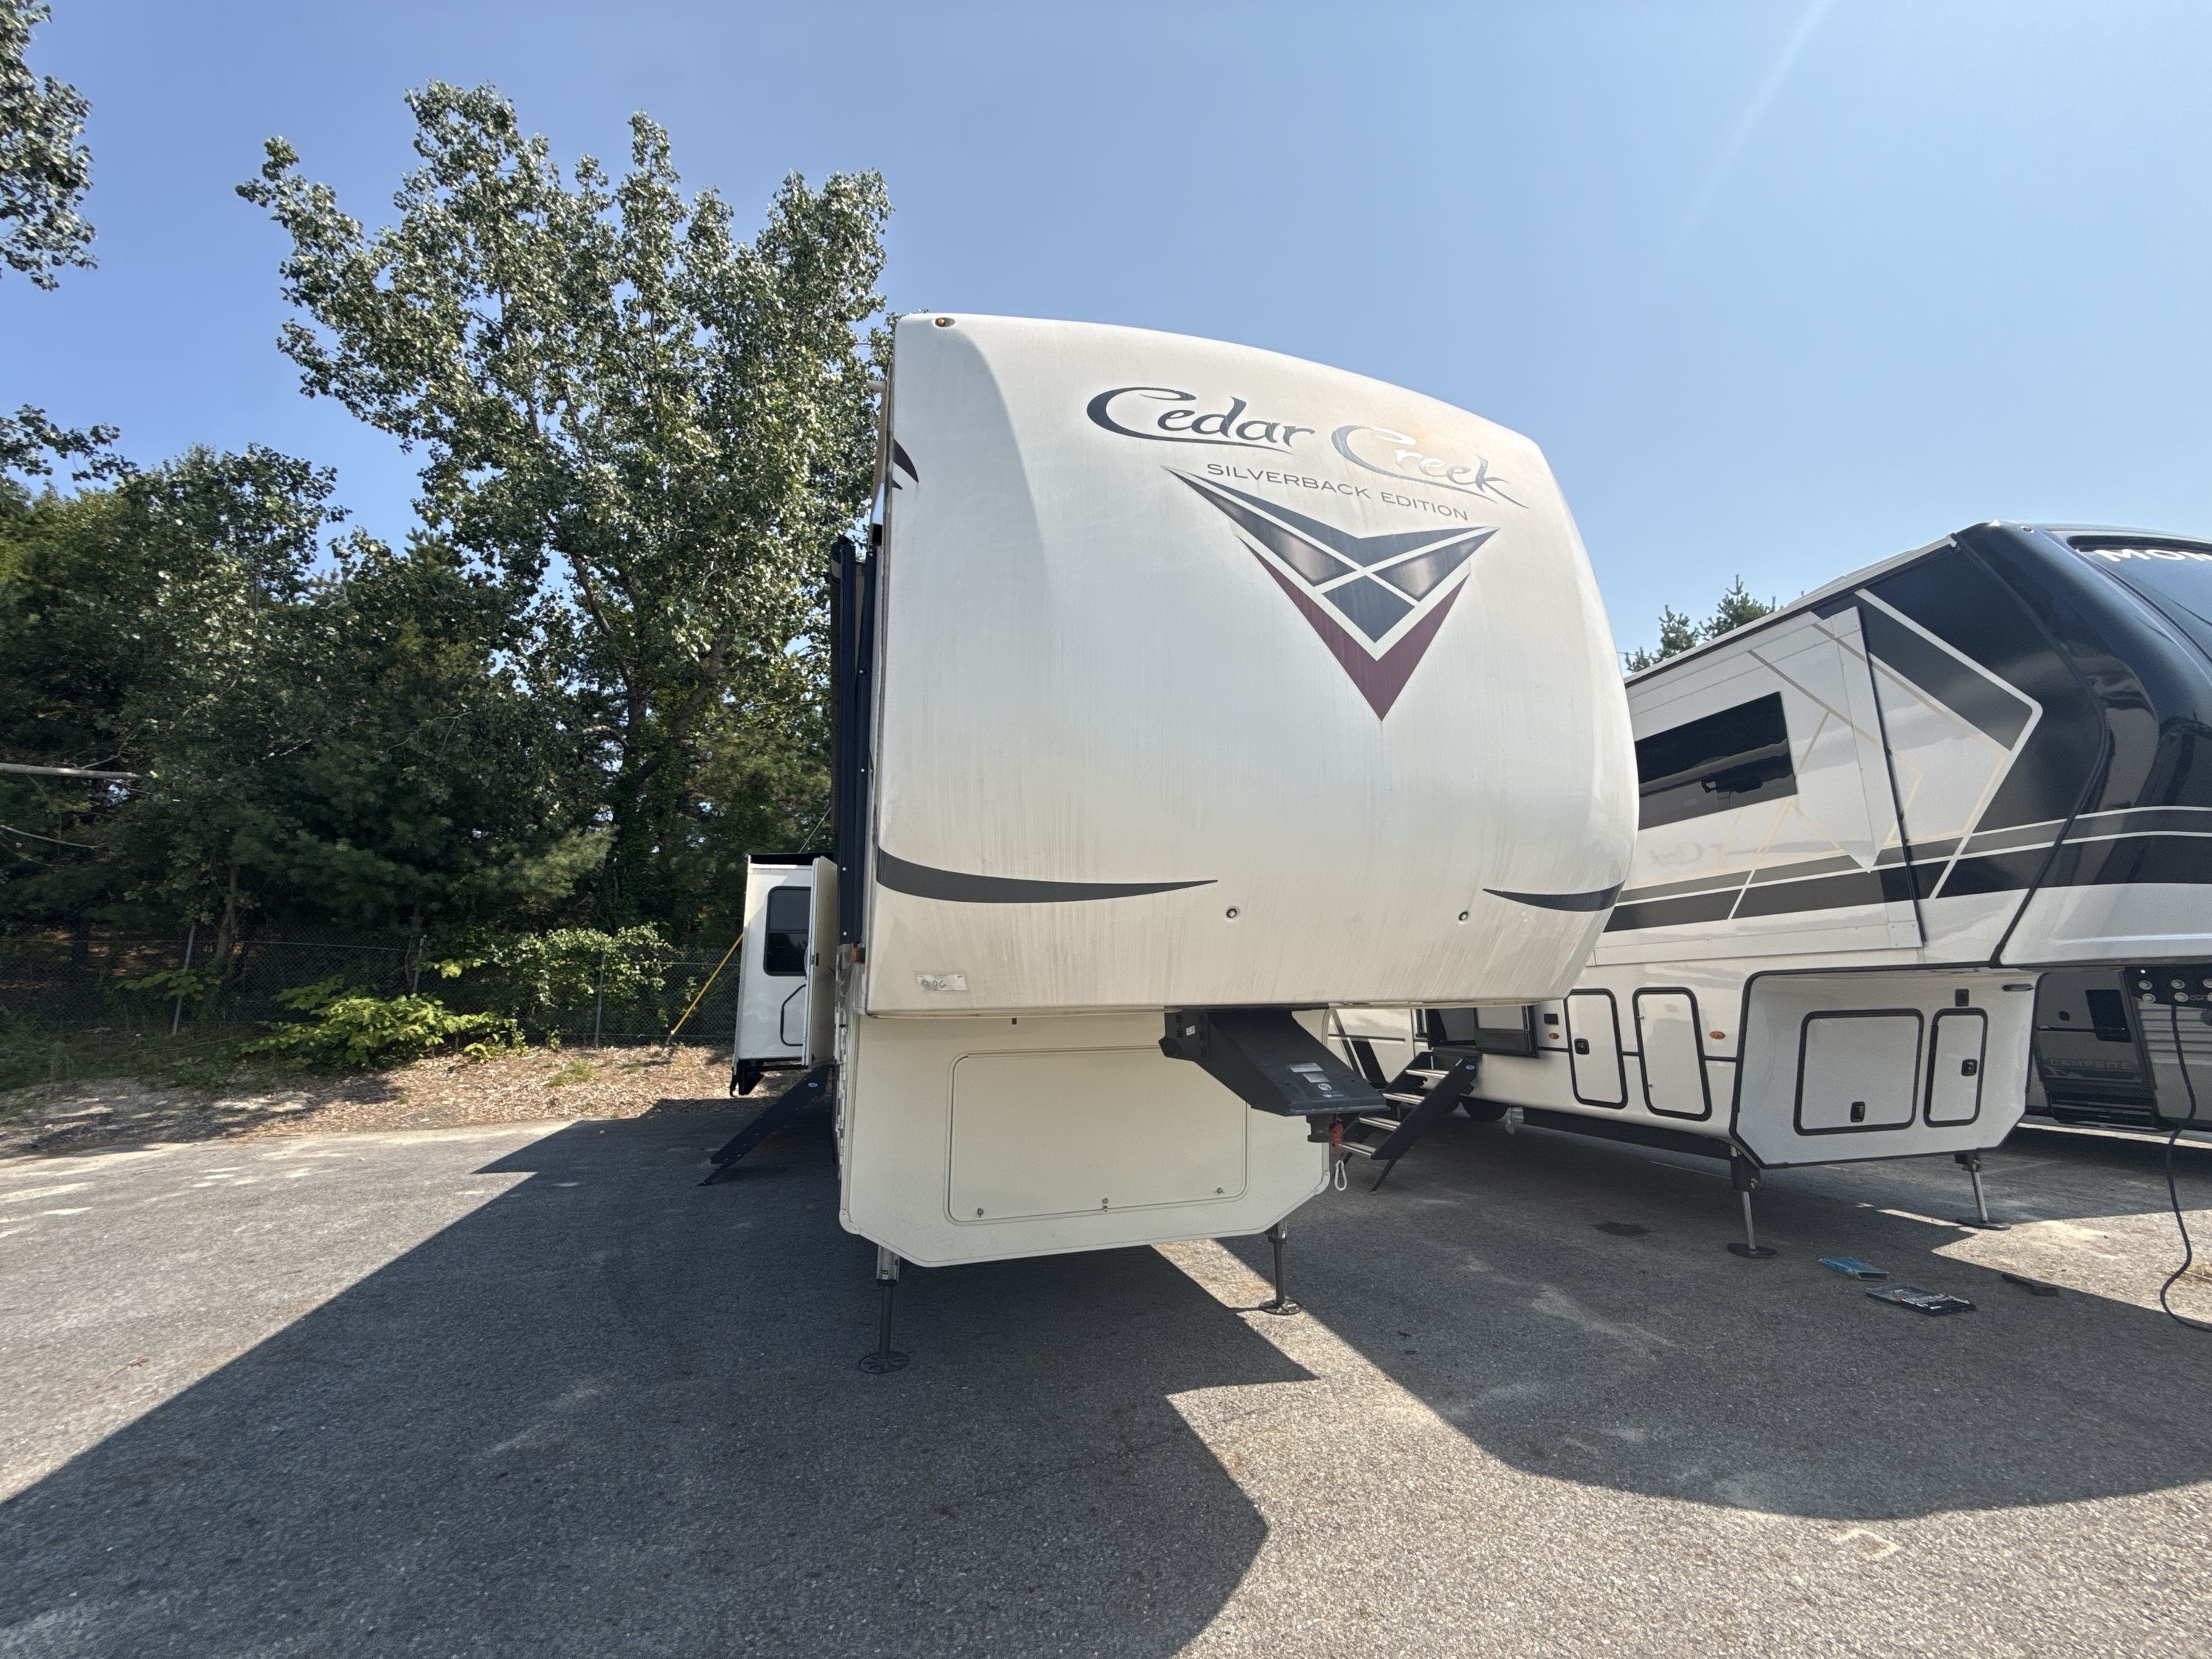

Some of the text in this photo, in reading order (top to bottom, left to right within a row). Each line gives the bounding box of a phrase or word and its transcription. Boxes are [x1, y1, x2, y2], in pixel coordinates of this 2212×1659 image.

[1087, 387, 1530, 509] Cedar Creek
[1207, 463, 1469, 521] SILVERBACK EDITION
